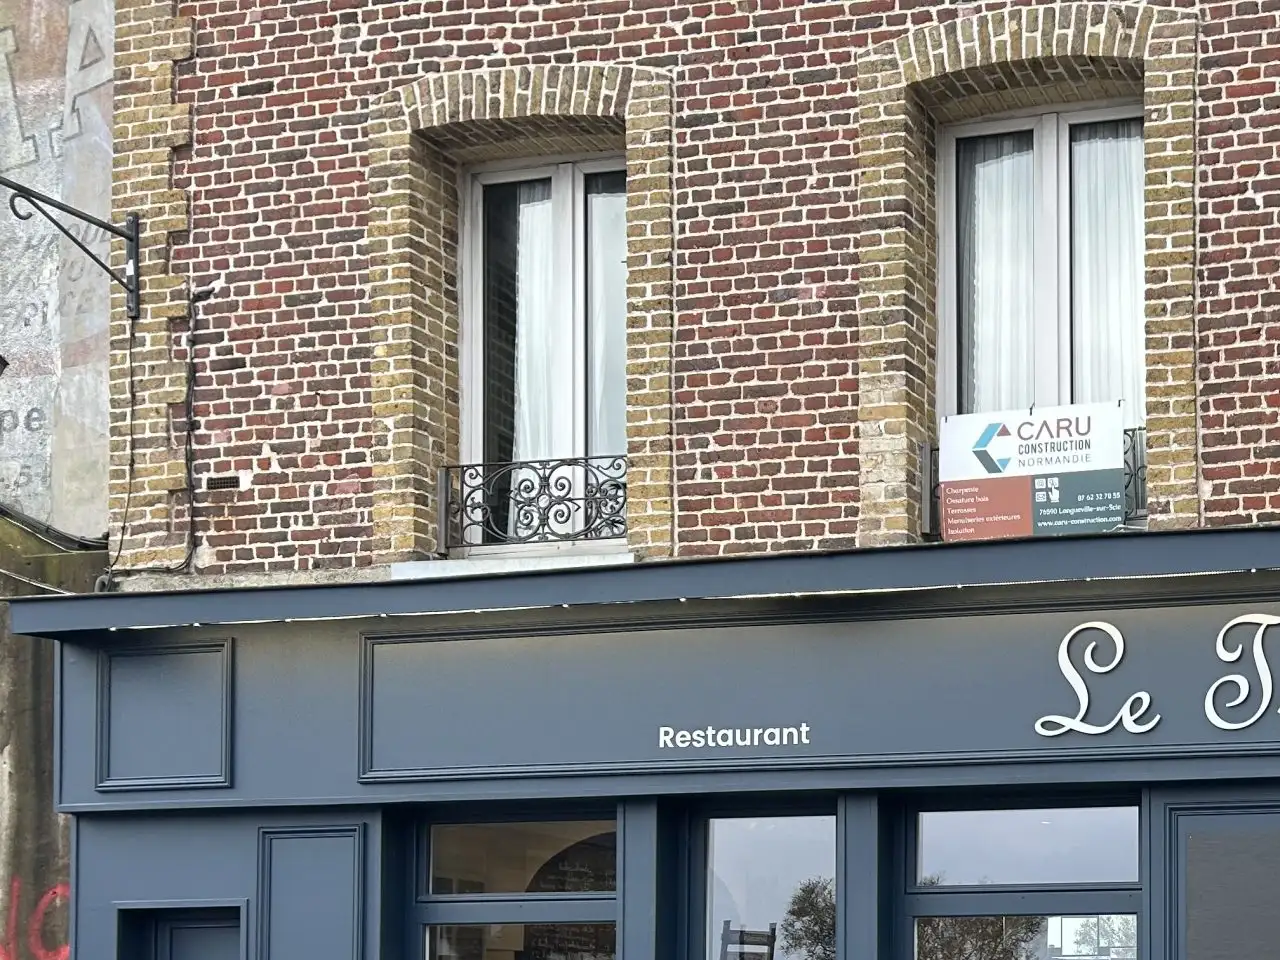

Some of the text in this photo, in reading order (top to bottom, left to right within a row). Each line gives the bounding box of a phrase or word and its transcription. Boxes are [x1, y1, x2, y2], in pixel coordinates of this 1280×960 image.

[1017, 416, 1091, 441] CARU
[1018, 439, 1091, 455] CONSTRUCTION
[1018, 453, 1092, 468] NORMANDIE
[1032, 619, 1162, 738] Le
[659, 722, 811, 748] Restaurant
